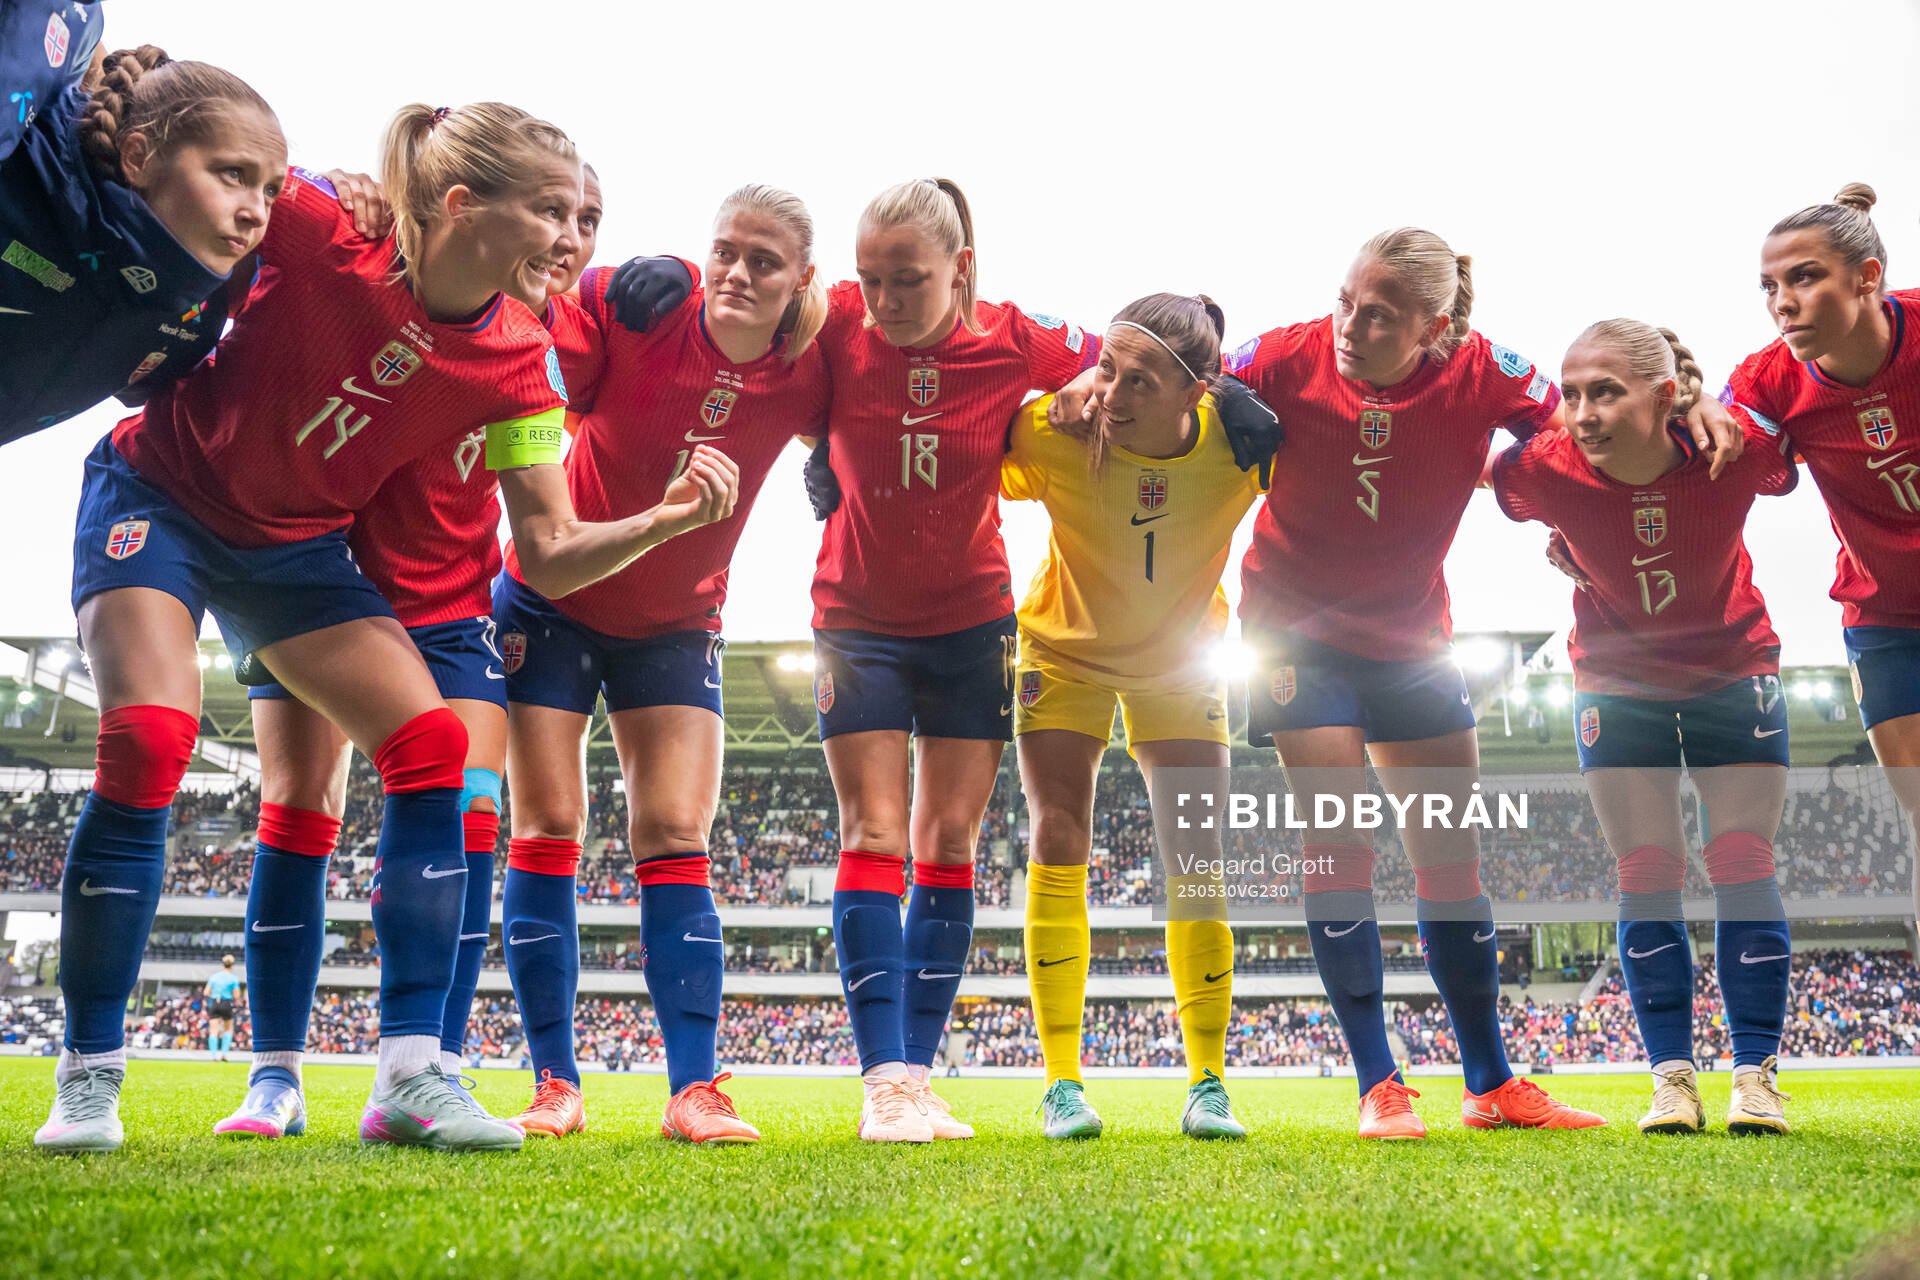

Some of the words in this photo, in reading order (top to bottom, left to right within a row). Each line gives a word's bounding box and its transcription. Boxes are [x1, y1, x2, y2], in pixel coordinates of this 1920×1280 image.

[295, 396, 372, 460] 14
[899, 433, 939, 491] 18
[1356, 470, 1380, 523] 5
[1144, 531, 1155, 585] 1
[1634, 569, 1678, 617] 13
